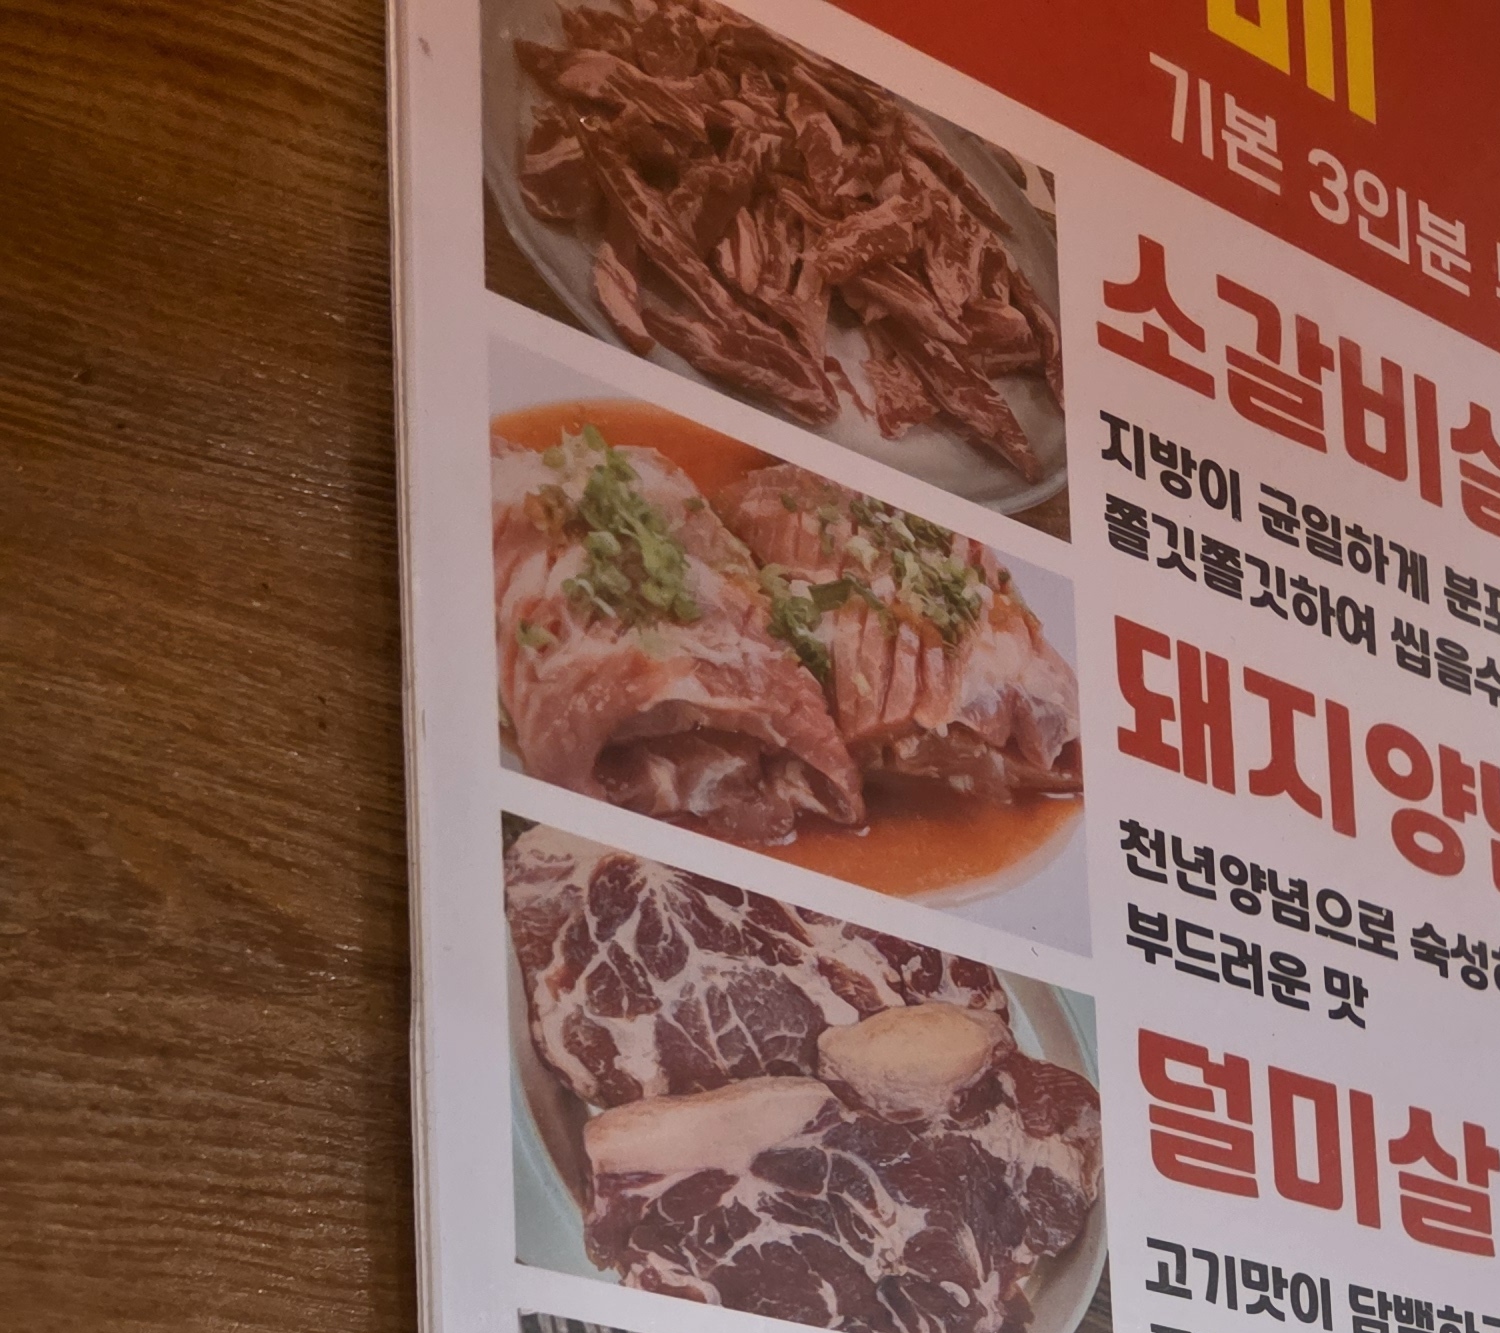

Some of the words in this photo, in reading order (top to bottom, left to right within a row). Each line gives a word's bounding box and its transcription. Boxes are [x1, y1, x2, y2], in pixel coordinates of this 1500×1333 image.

[1149, 51, 1283, 196] 기본
[1308, 148, 1471, 297] 3인분
[1100, 410, 1242, 522] 지방이
[1258, 482, 1430, 605] 균일하게
[1104, 493, 1377, 656] 쫄깃쫄깃하여
[1119, 818, 1398, 961] 천년양념으로
[1126, 902, 1311, 1011] 부드러운
[1324, 965, 1369, 1029] 맛
[1138, 1027, 1500, 1257] 덜미살
[1145, 1236, 1334, 1331] 고기맛이
